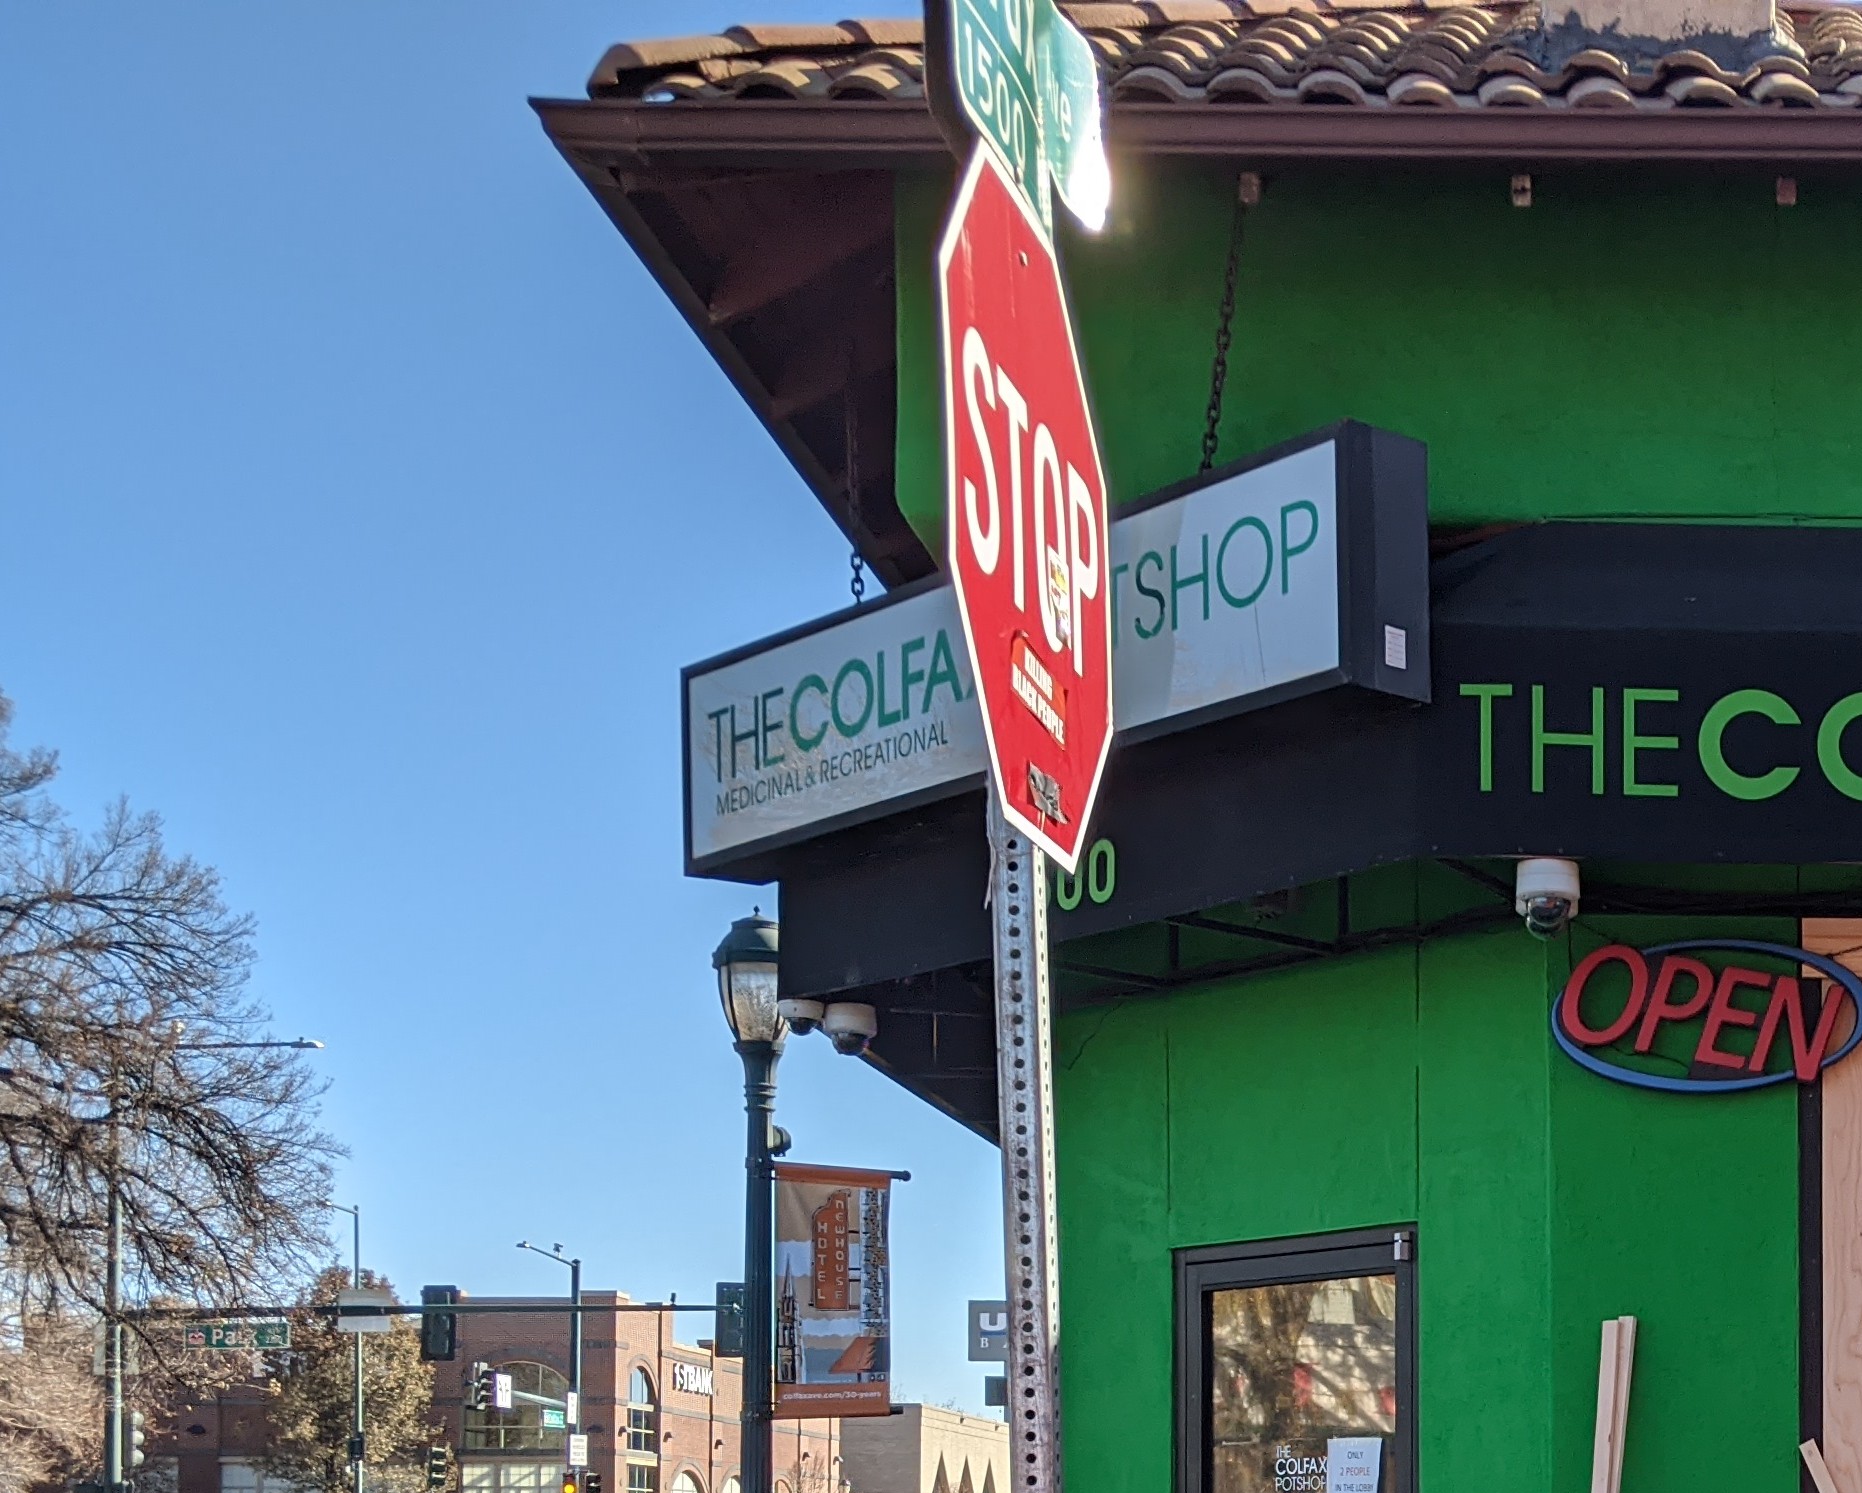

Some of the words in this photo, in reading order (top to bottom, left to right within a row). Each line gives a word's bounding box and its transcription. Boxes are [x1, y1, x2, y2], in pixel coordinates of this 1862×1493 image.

[965, 22, 1026, 171] 1500
[963, 326, 1098, 678] STOP
[1012, 662, 1038, 717] BLACK
[1037, 696, 1065, 745] PEOPLE
[1024, 646, 1053, 701] KILLING
[716, 774, 804, 816] MEDICINAL
[805, 765, 818, 789] &
[819, 720, 949, 784] RECREATIONAL
[1561, 944, 1846, 1082] OPEN
[816, 1222, 828, 1300] HOTEL
[1275, 1457, 1327, 1475] COLFAX
[1276, 1445, 1292, 1458] THE
[1346, 1467, 1371, 1476] PEOPLE
[1347, 1451, 1364, 1459] ONLY
[1343, 1484, 1355, 1492] THE
[1355, 1484, 1374, 1492] LOBBY
